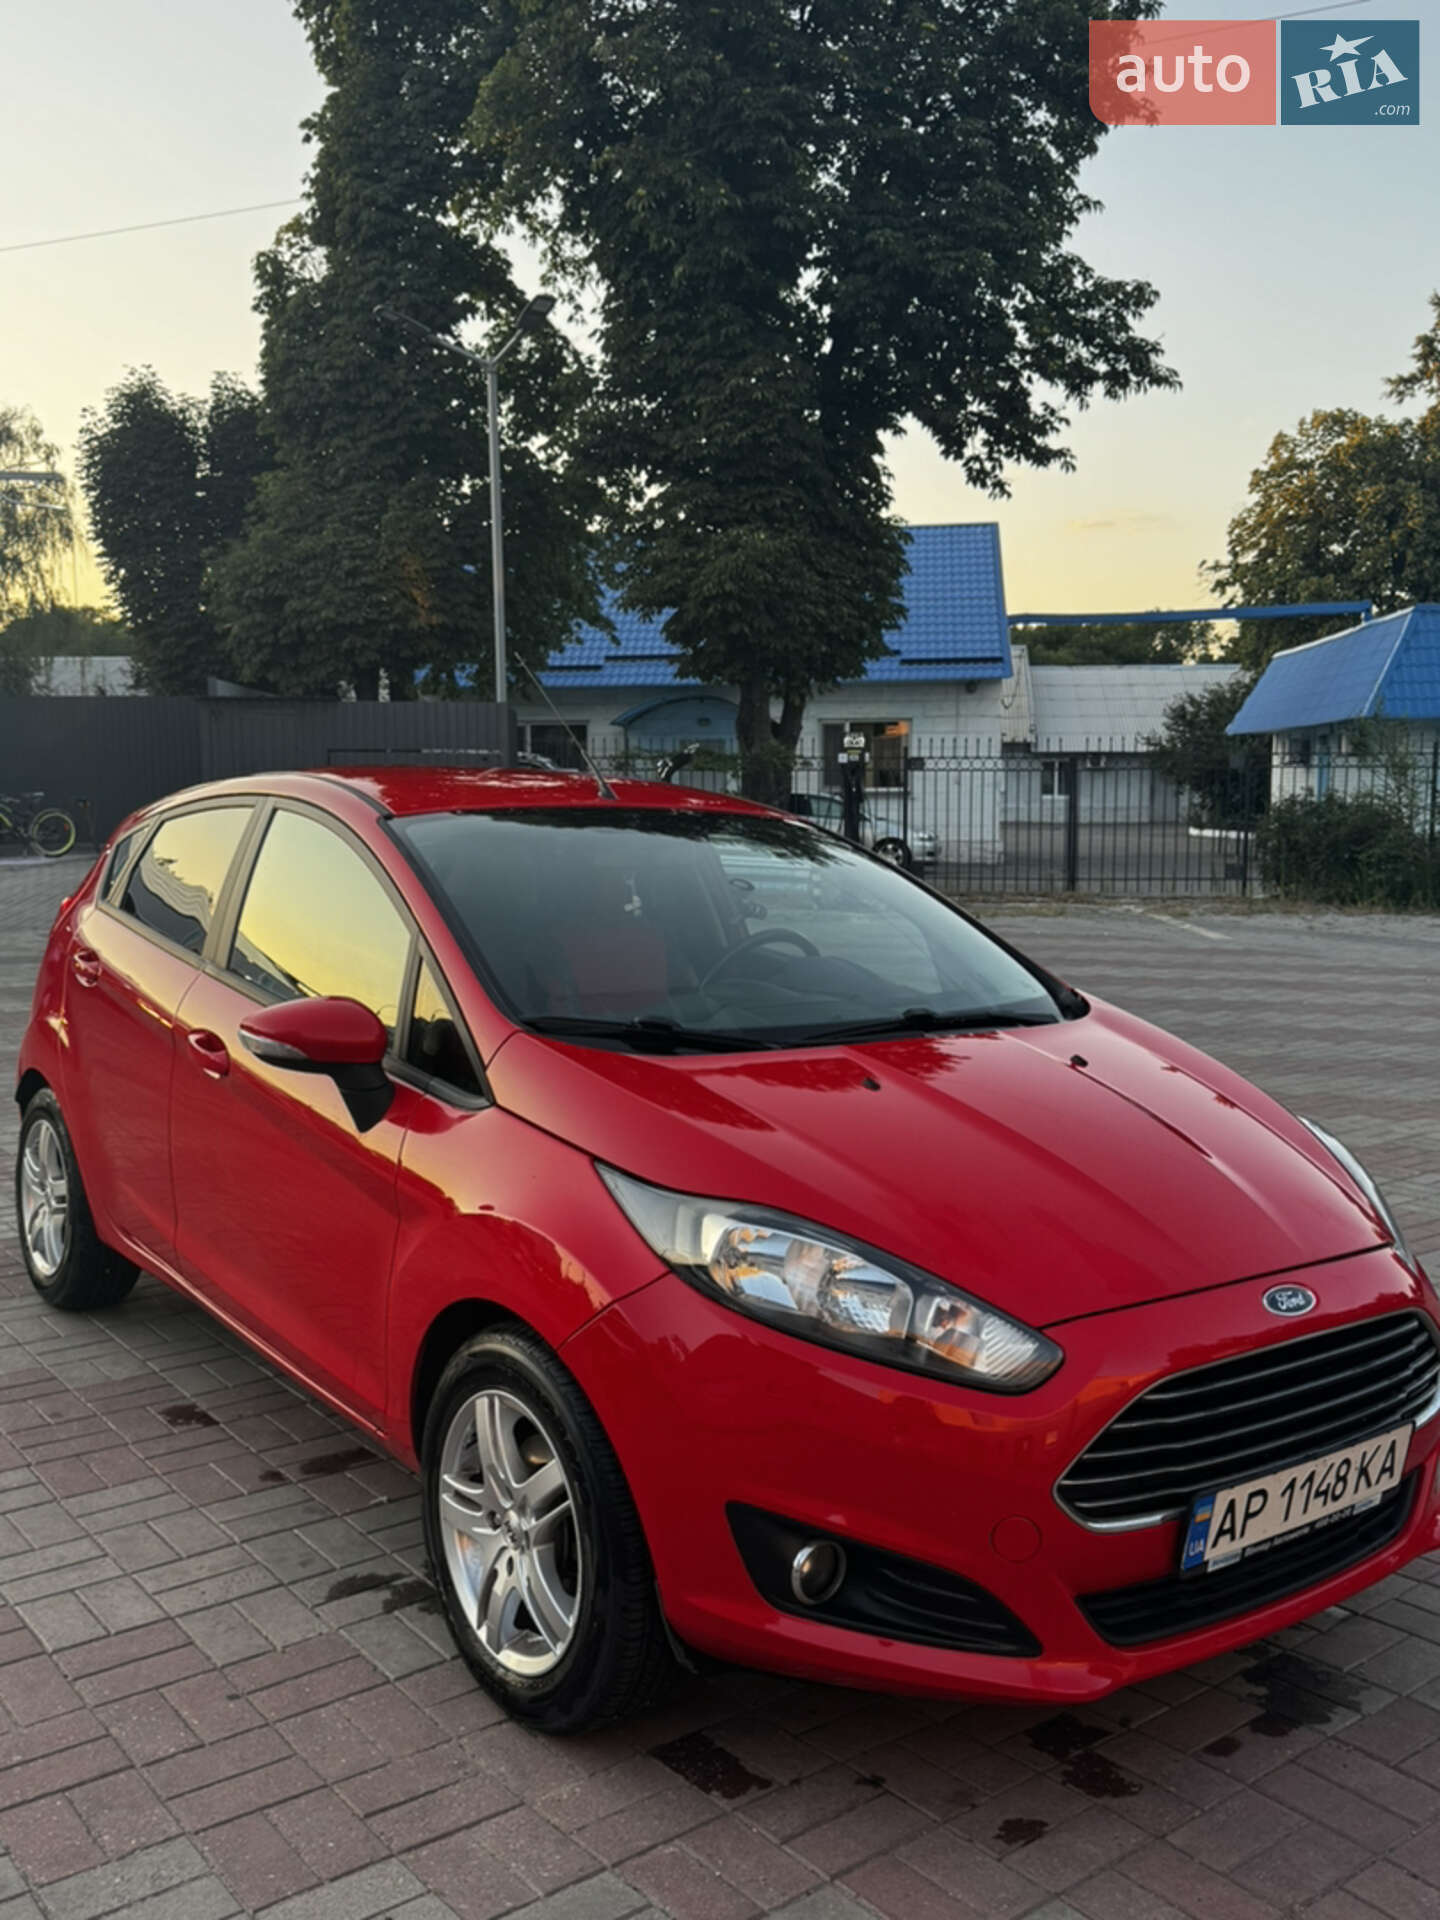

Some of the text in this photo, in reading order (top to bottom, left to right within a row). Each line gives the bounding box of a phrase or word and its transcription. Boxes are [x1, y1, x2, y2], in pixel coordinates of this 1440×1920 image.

[1275, 1290, 1306, 1310] Ford
[1210, 1438, 1398, 1549] AP 1148 KA
[1188, 1538, 1205, 1556] UA
